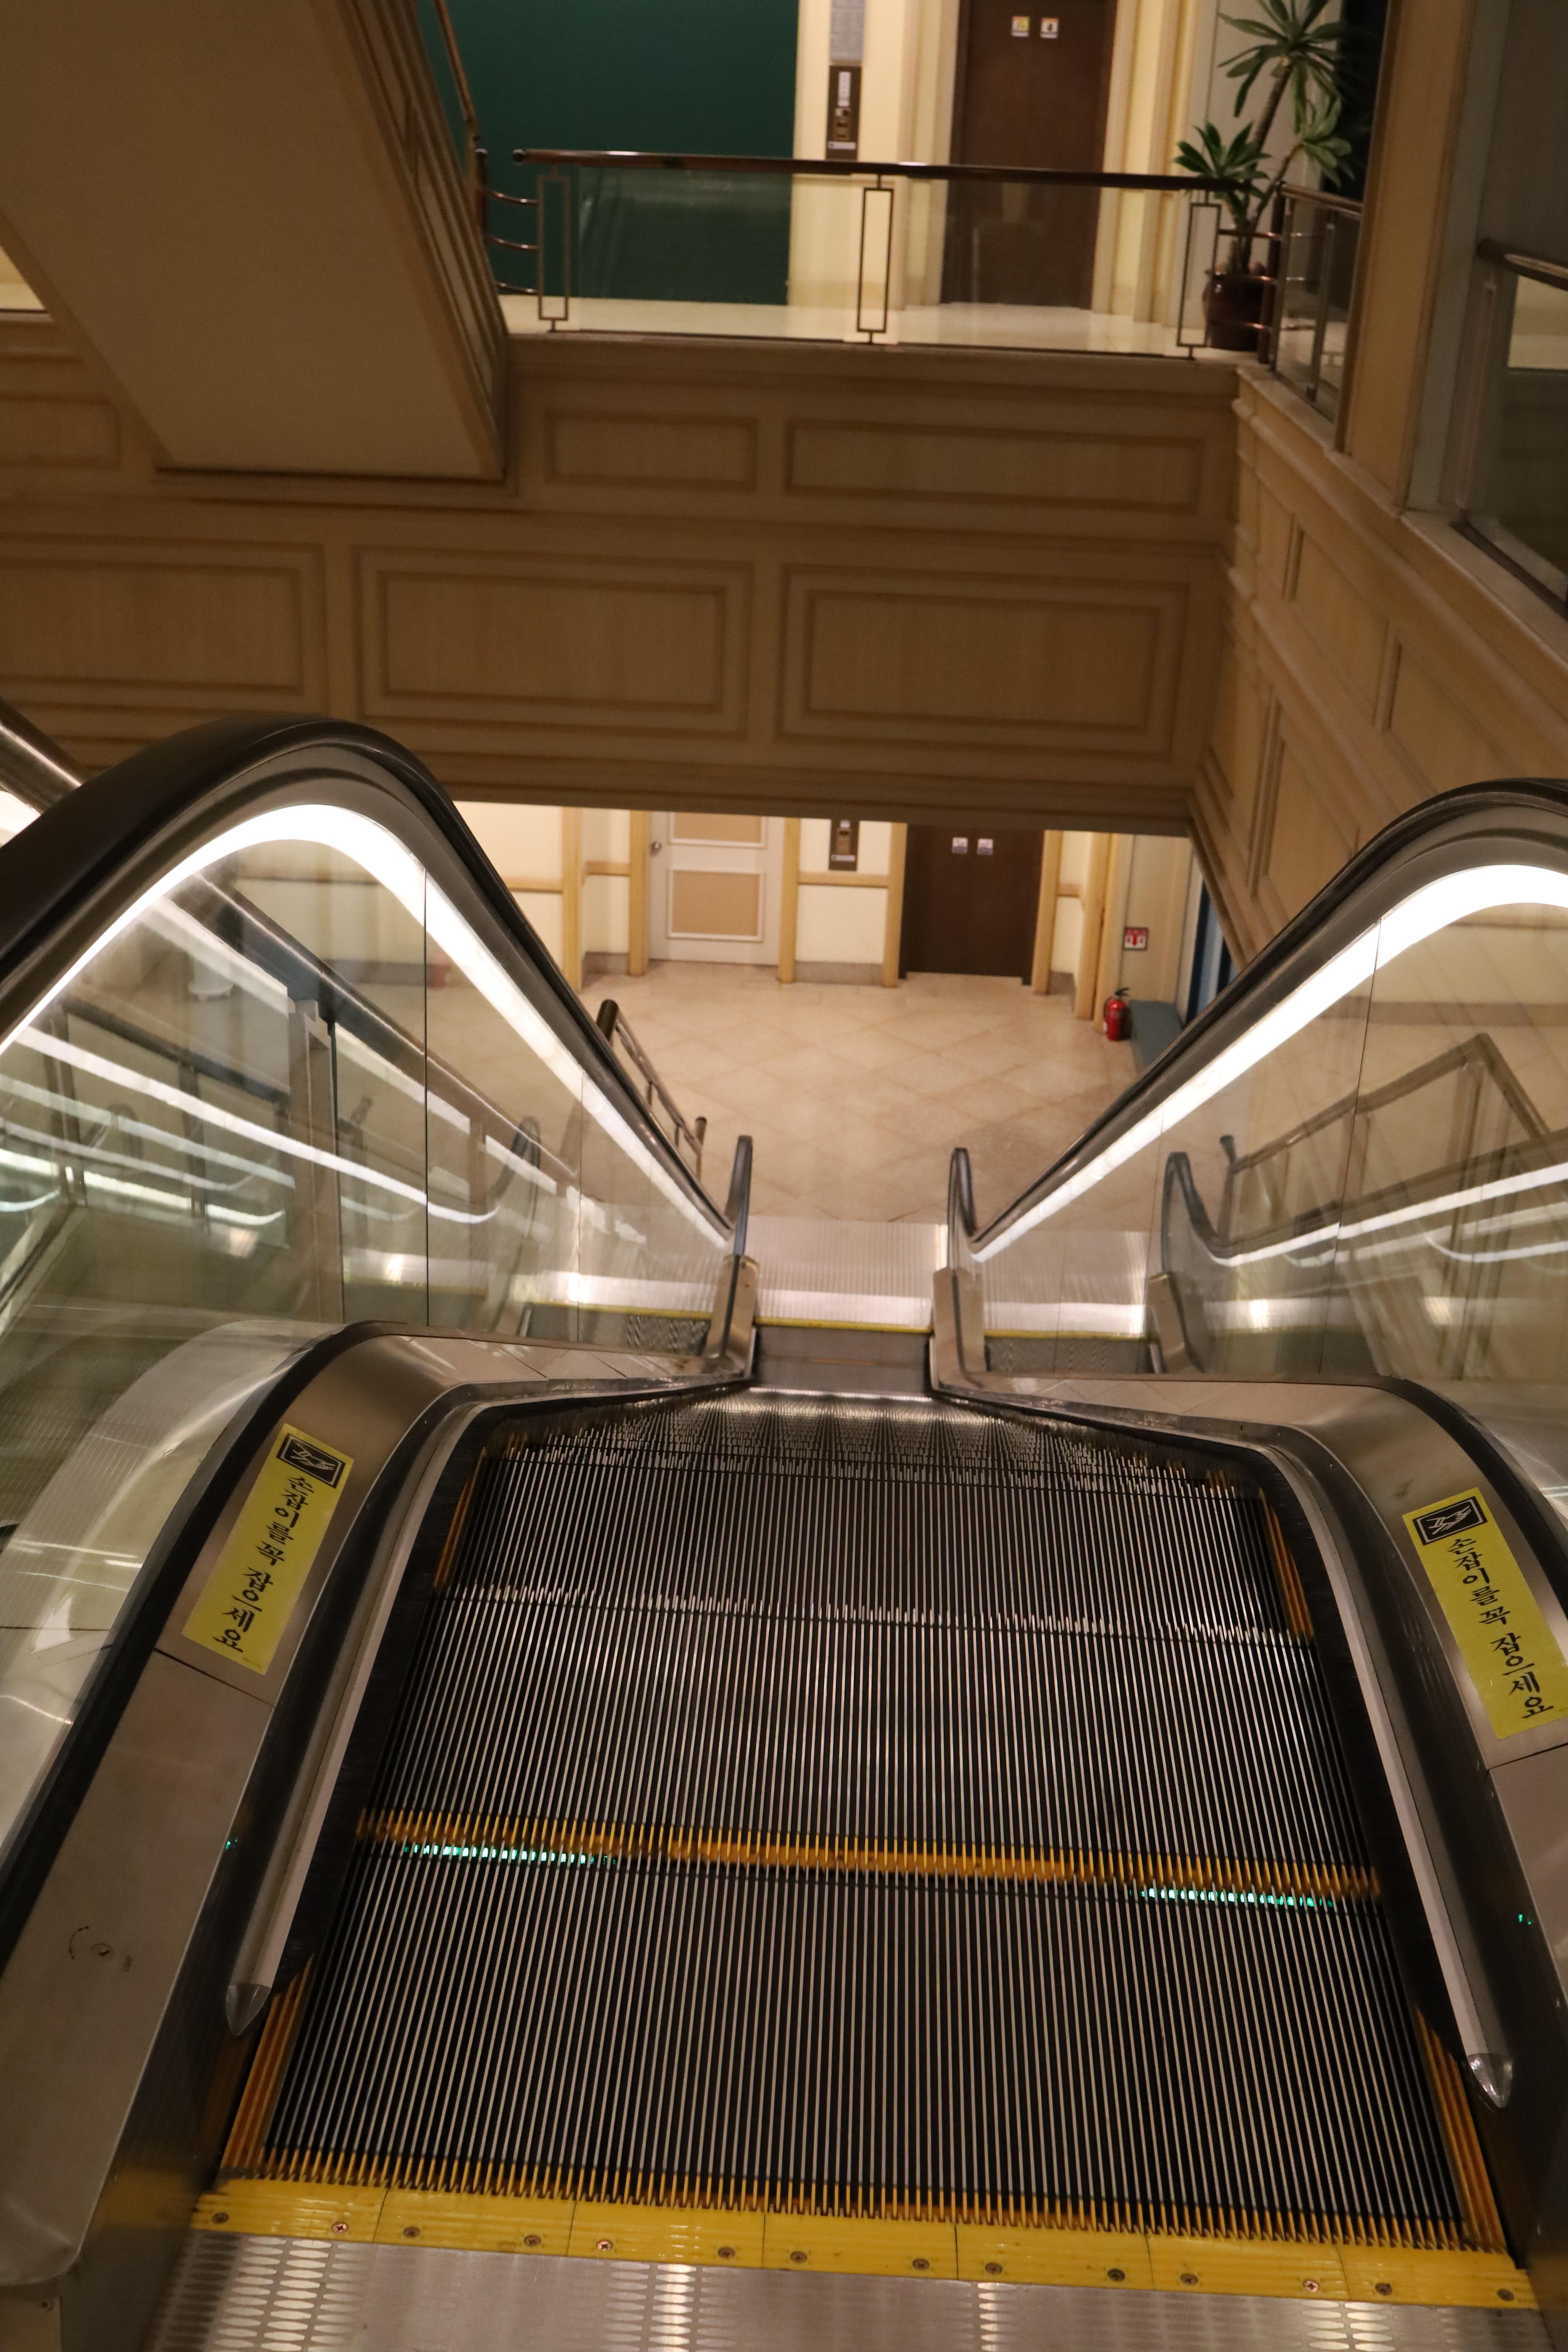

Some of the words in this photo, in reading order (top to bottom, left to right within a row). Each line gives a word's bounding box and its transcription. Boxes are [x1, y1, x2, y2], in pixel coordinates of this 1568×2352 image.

[265, 1476, 315, 1545] 손잡이를
[256, 1540, 285, 1566] 꼭
[1447, 1539, 1500, 1606] 손잡이를
[213, 1566, 274, 1653] 잡으세요
[1479, 1606, 1511, 1625] 꼭
[1490, 1632, 1554, 1718] 잡으세요
